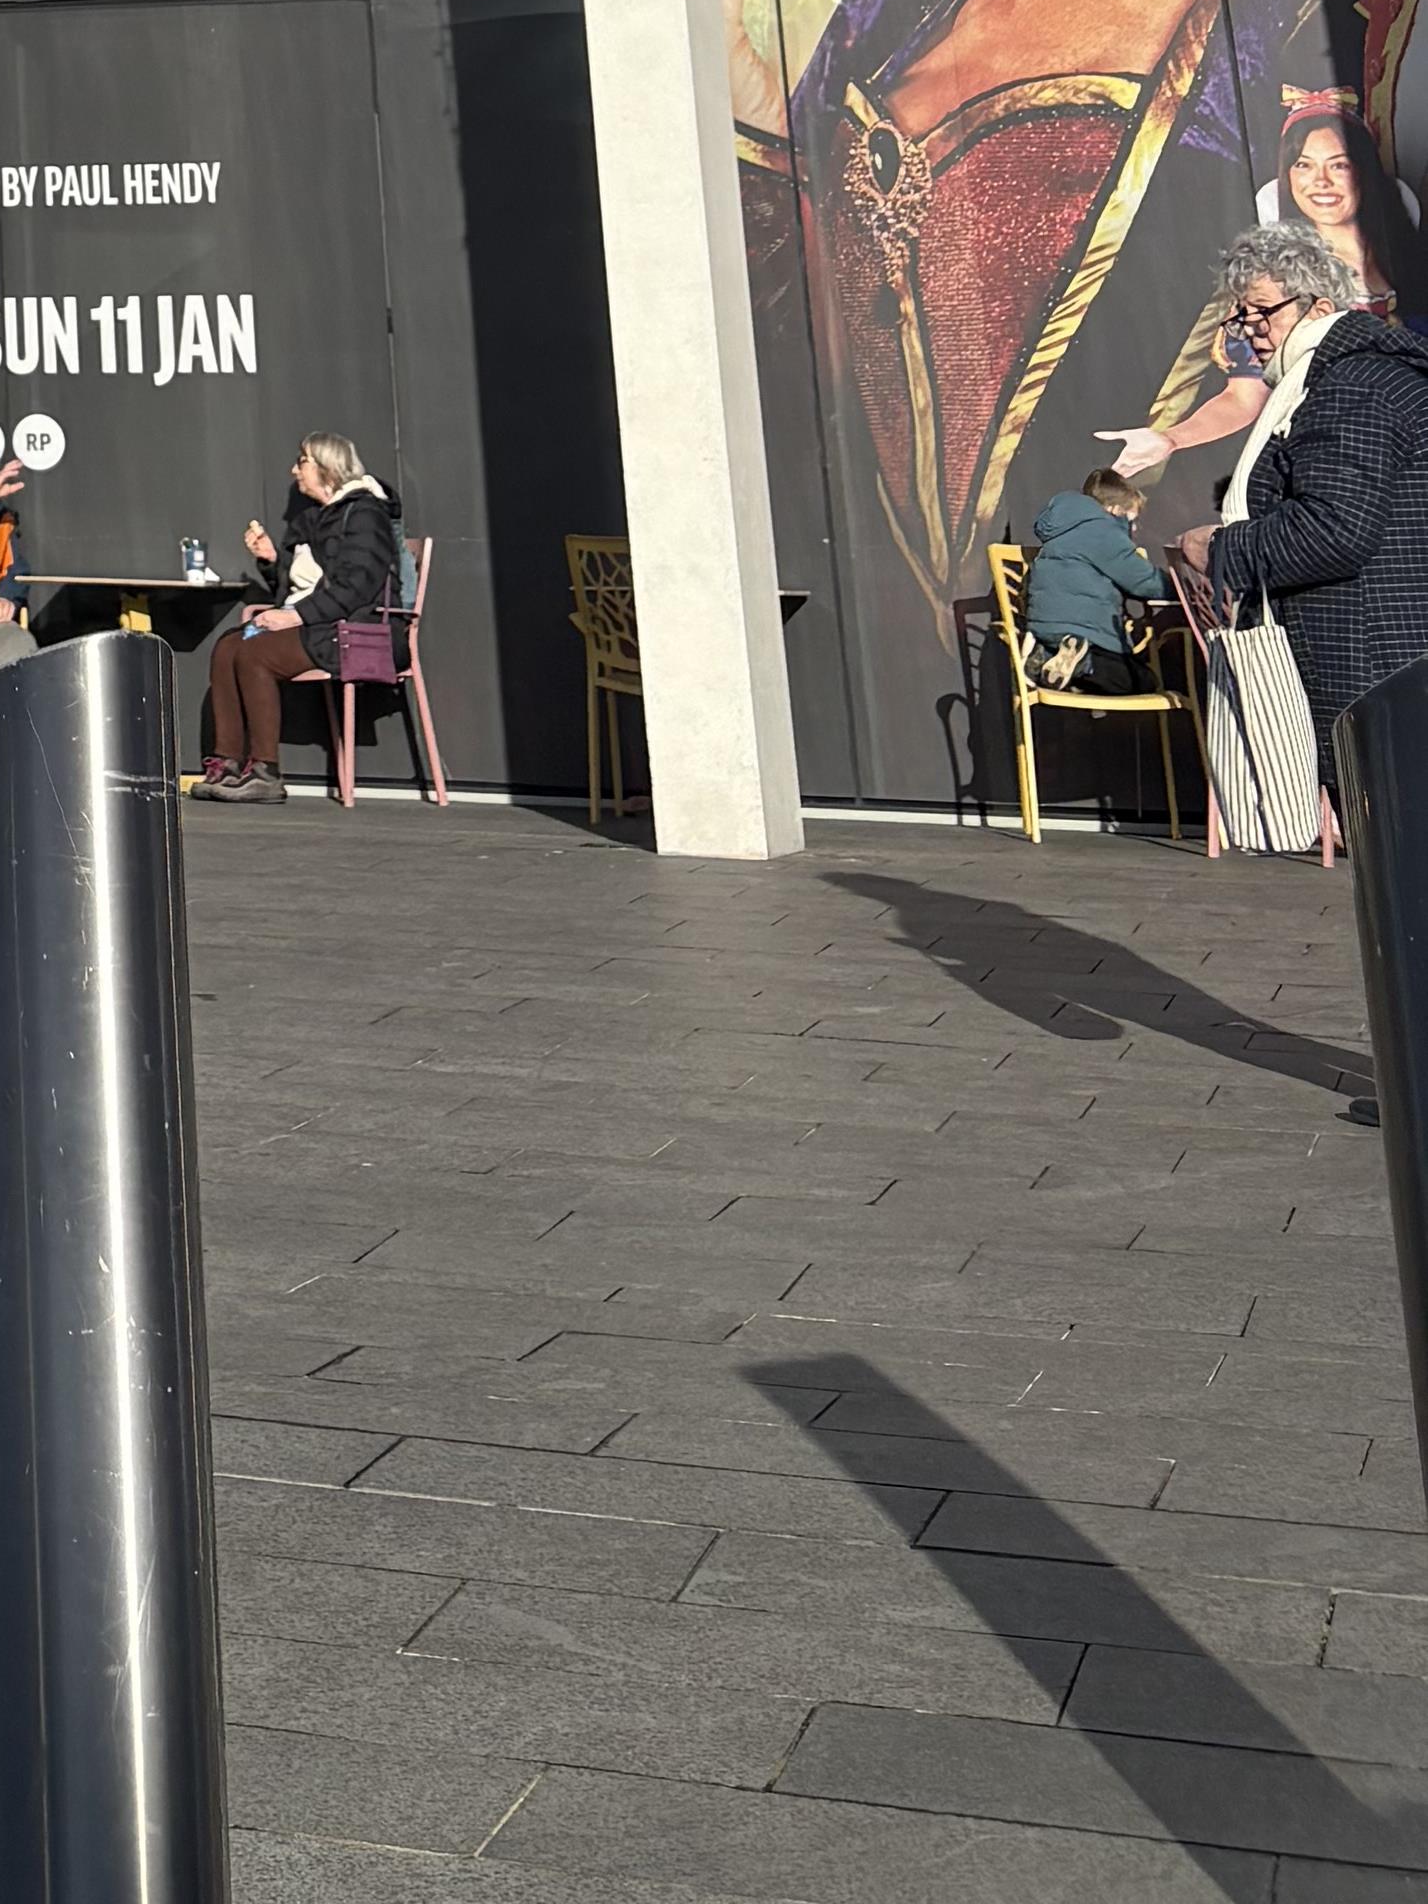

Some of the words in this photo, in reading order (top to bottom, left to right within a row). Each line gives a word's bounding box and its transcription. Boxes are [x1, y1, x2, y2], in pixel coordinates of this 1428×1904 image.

[1, 165, 40, 208] BY
[44, 164, 119, 207] PAUL
[123, 162, 222, 206] HENDY
[90, 295, 144, 374] 11
[153, 294, 258, 387] JAN
[25, 432, 52, 451] RP
